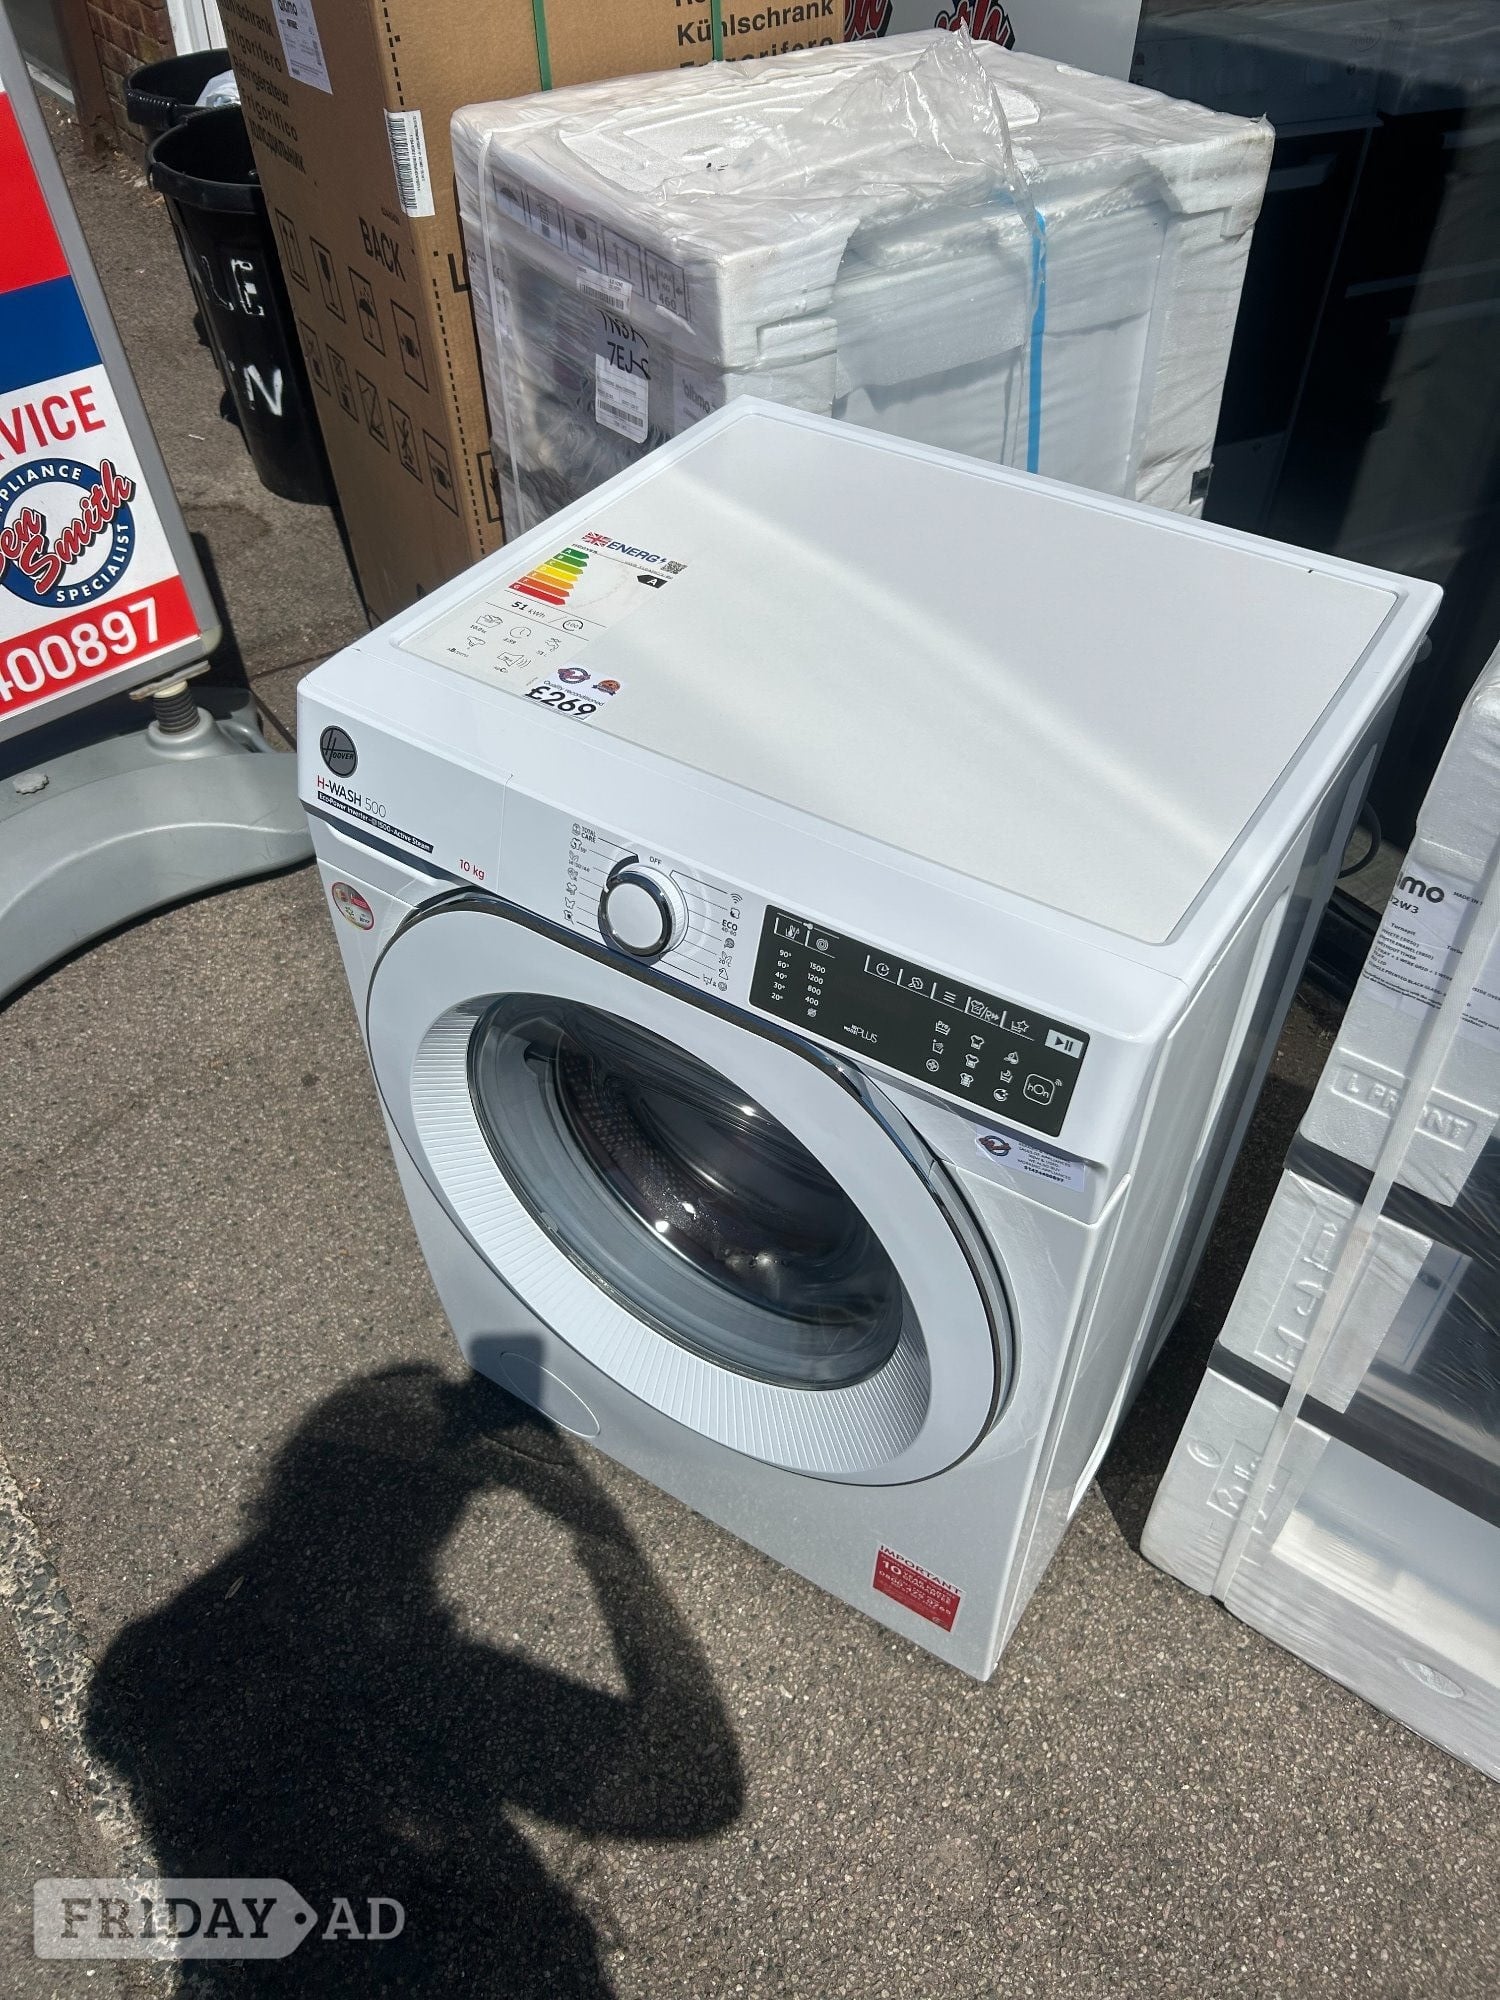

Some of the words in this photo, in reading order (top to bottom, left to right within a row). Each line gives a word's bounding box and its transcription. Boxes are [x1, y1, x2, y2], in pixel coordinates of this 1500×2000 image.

[359, 216, 406, 282] BACK
[0, 385, 106, 461] VICE
[0, 464, 82, 514] PLIANCE
[19, 459, 137, 596] Smith
[0, 507, 46, 577] en
[607, 541, 662, 563] ENERG
[56, 523, 130, 603] SPECIALIST
[647, 578, 657, 586] A
[511, 601, 528, 611] 51
[543, 680, 563, 691] Quality
[525, 686, 597, 716] £269
[317, 775, 362, 807] H-WASH
[365, 797, 387, 818] 500
[347, 805, 370, 822] Inverter
[393, 828, 412, 843] Active
[412, 836, 432, 851] Steam
[581, 832, 596, 844] CARE
[649, 856, 662, 866] OFF
[459, 859, 470, 872] 10
[472, 864, 485, 881] kg
[1391, 896, 1419, 914] 2W3
[722, 919, 738, 931] ECO
[774, 971, 788, 980] 40°
[809, 961, 826, 974] 1500
[773, 982, 786, 990] 30°
[807, 973, 824, 985] 1200
[771, 992, 784, 1001] 20°
[807, 984, 822, 996] 800
[804, 996, 819, 1006] 400
[856, 1026, 878, 1043] PLUS
[880, 1545, 962, 1595] IMPORTANT
[882, 1560, 901, 1575] 10
